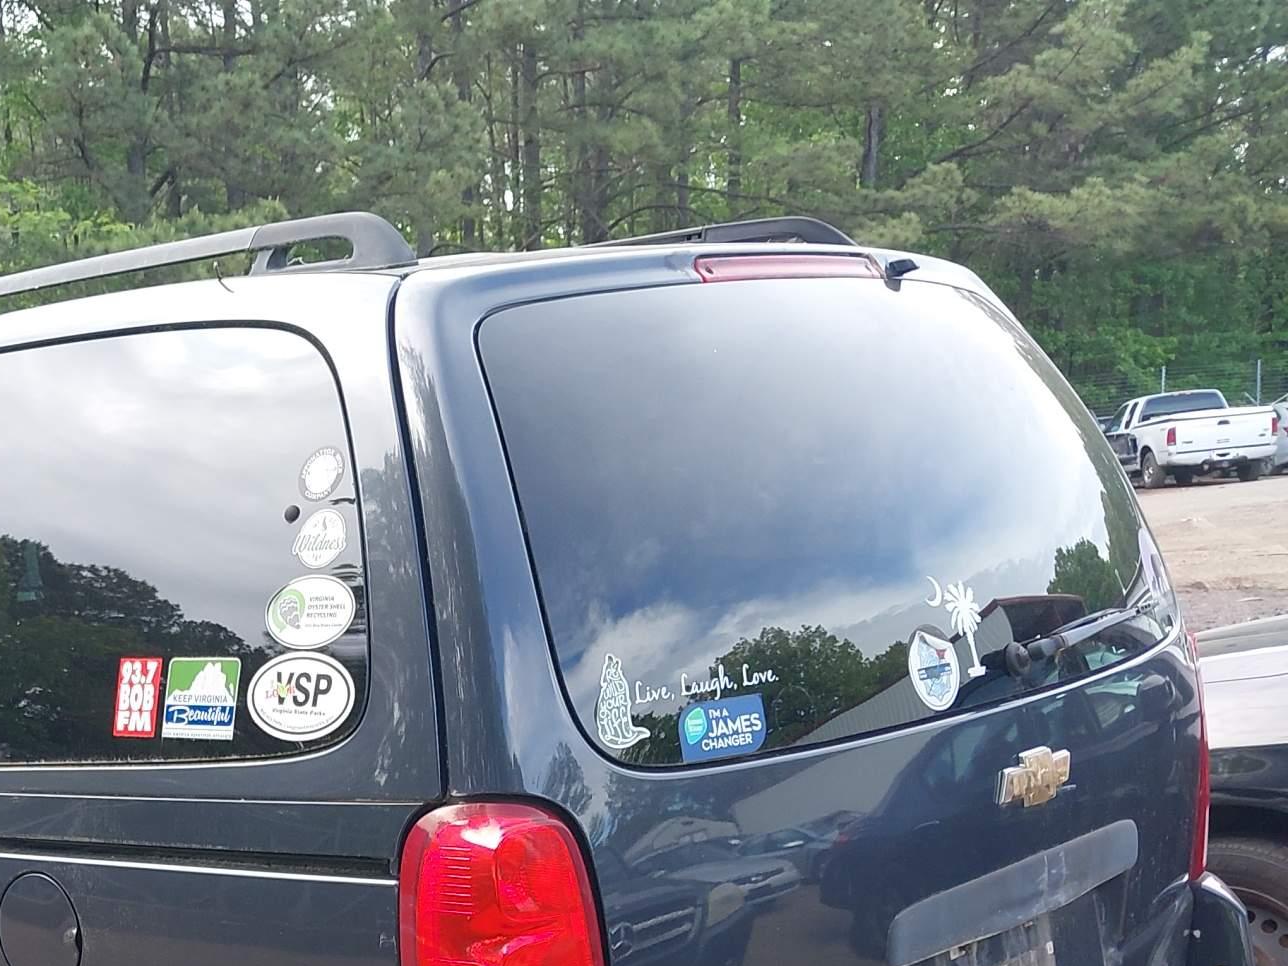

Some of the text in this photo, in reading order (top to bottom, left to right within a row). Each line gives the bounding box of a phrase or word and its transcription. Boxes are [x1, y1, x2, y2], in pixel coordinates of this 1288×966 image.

[121, 661, 158, 684] 93.7
[119, 683, 155, 711] BOB
[173, 694, 228, 703] KEEP VIRGINIA
[277, 672, 333, 707] VSP
[116, 710, 152, 732] FM
[167, 705, 231, 726] Beautiful
[721, 707, 729, 718] A
[708, 713, 762, 738] JAMES
[701, 733, 753, 751] CHANGER
